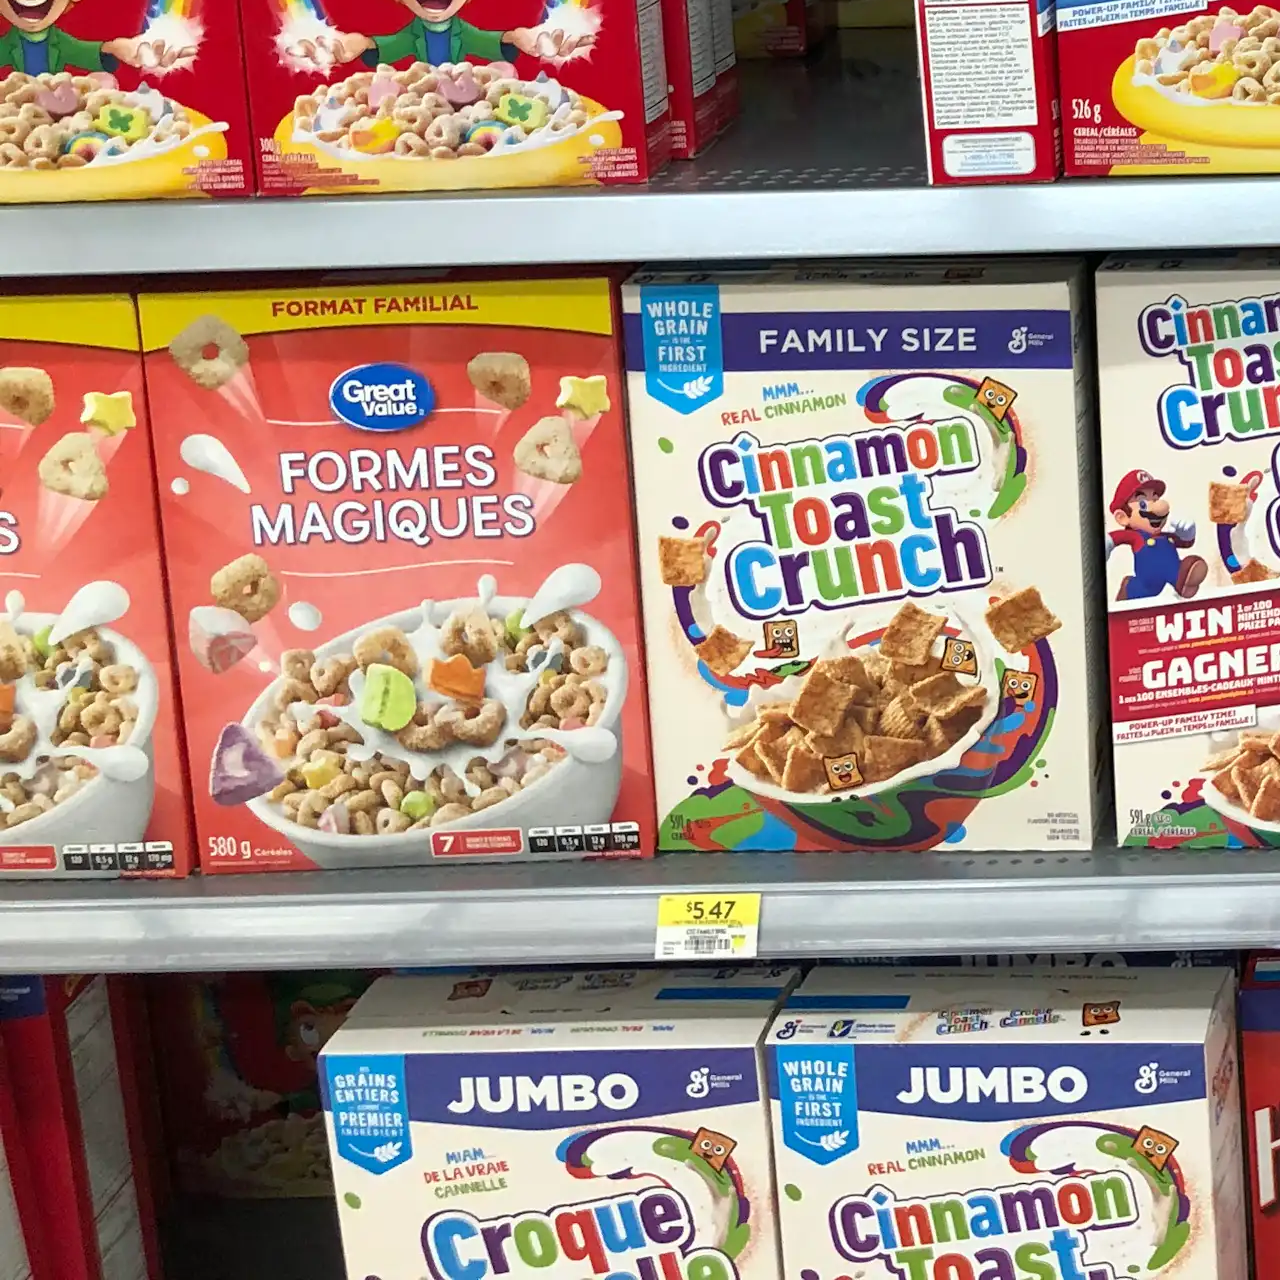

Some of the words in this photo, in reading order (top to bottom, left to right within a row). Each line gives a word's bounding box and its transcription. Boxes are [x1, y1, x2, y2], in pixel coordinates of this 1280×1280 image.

[272, 298, 367, 317] FORMAT
[374, 294, 479, 313] FAMILIAL
[646, 300, 713, 319] WHOLE
[654, 319, 708, 336] GRAIN
[760, 328, 888, 354] FAMILY
[902, 328, 977, 352] SIZE
[658, 346, 706, 362] FIRST
[343, 379, 416, 402] Great
[361, 400, 418, 417] Value
[721, 407, 761, 426] REAL
[764, 392, 846, 419] CINNAMON
[280, 444, 496, 493] FORMES
[708, 421, 973, 499] Cinnamon
[250, 494, 535, 546] MAGIQUES
[760, 474, 933, 550] Toast
[735, 512, 987, 611] Crunch
[1155, 605, 1233, 643] WIN
[687, 901, 736, 920] $5.47
[447, 1072, 639, 1114] JUMBO
[897, 1065, 1088, 1104] JUMBO
[423, 1170, 439, 1184] DE
[441, 1166, 464, 1181] LA
[466, 1160, 510, 1179] VRAIE
[868, 1159, 906, 1176] REAL
[908, 1146, 986, 1169] CINNAMON
[434, 1177, 508, 1199] CANNELLE
[843, 1174, 1131, 1253] Cinnamon
[433, 1193, 686, 1280] Croque
